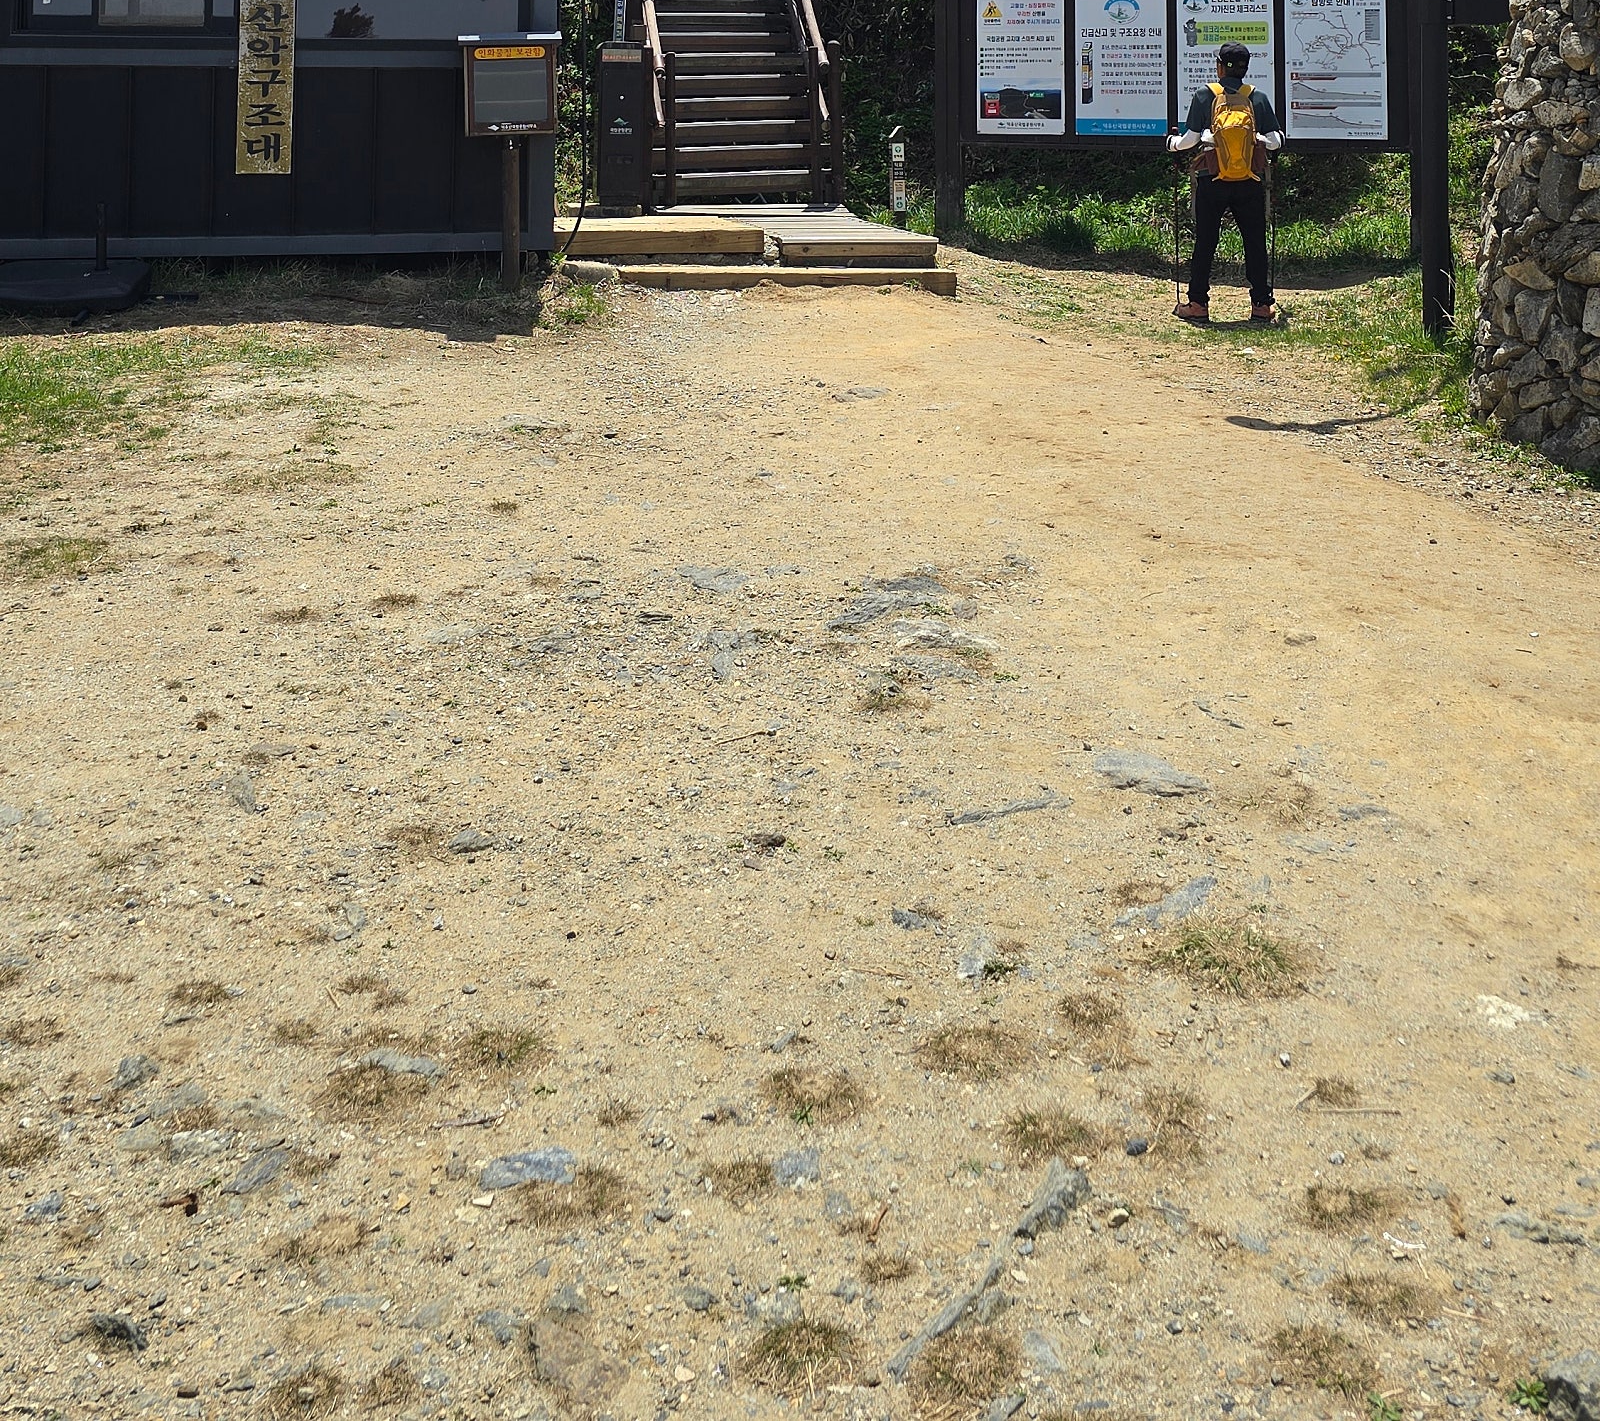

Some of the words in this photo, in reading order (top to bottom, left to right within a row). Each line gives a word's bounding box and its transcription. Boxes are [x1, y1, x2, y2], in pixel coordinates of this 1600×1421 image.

[1211, 5, 1236, 13] 자가진단
[1237, 4, 1267, 13] 체크리스트
[1081, 28, 1108, 37] 긴급신고
[1110, 28, 1117, 37] 및
[1119, 28, 1146, 37] 구조요청
[1148, 28, 1162, 37] 안내
[478, 48, 512, 58] 인화물질
[516, 47, 541, 57] 보관함
